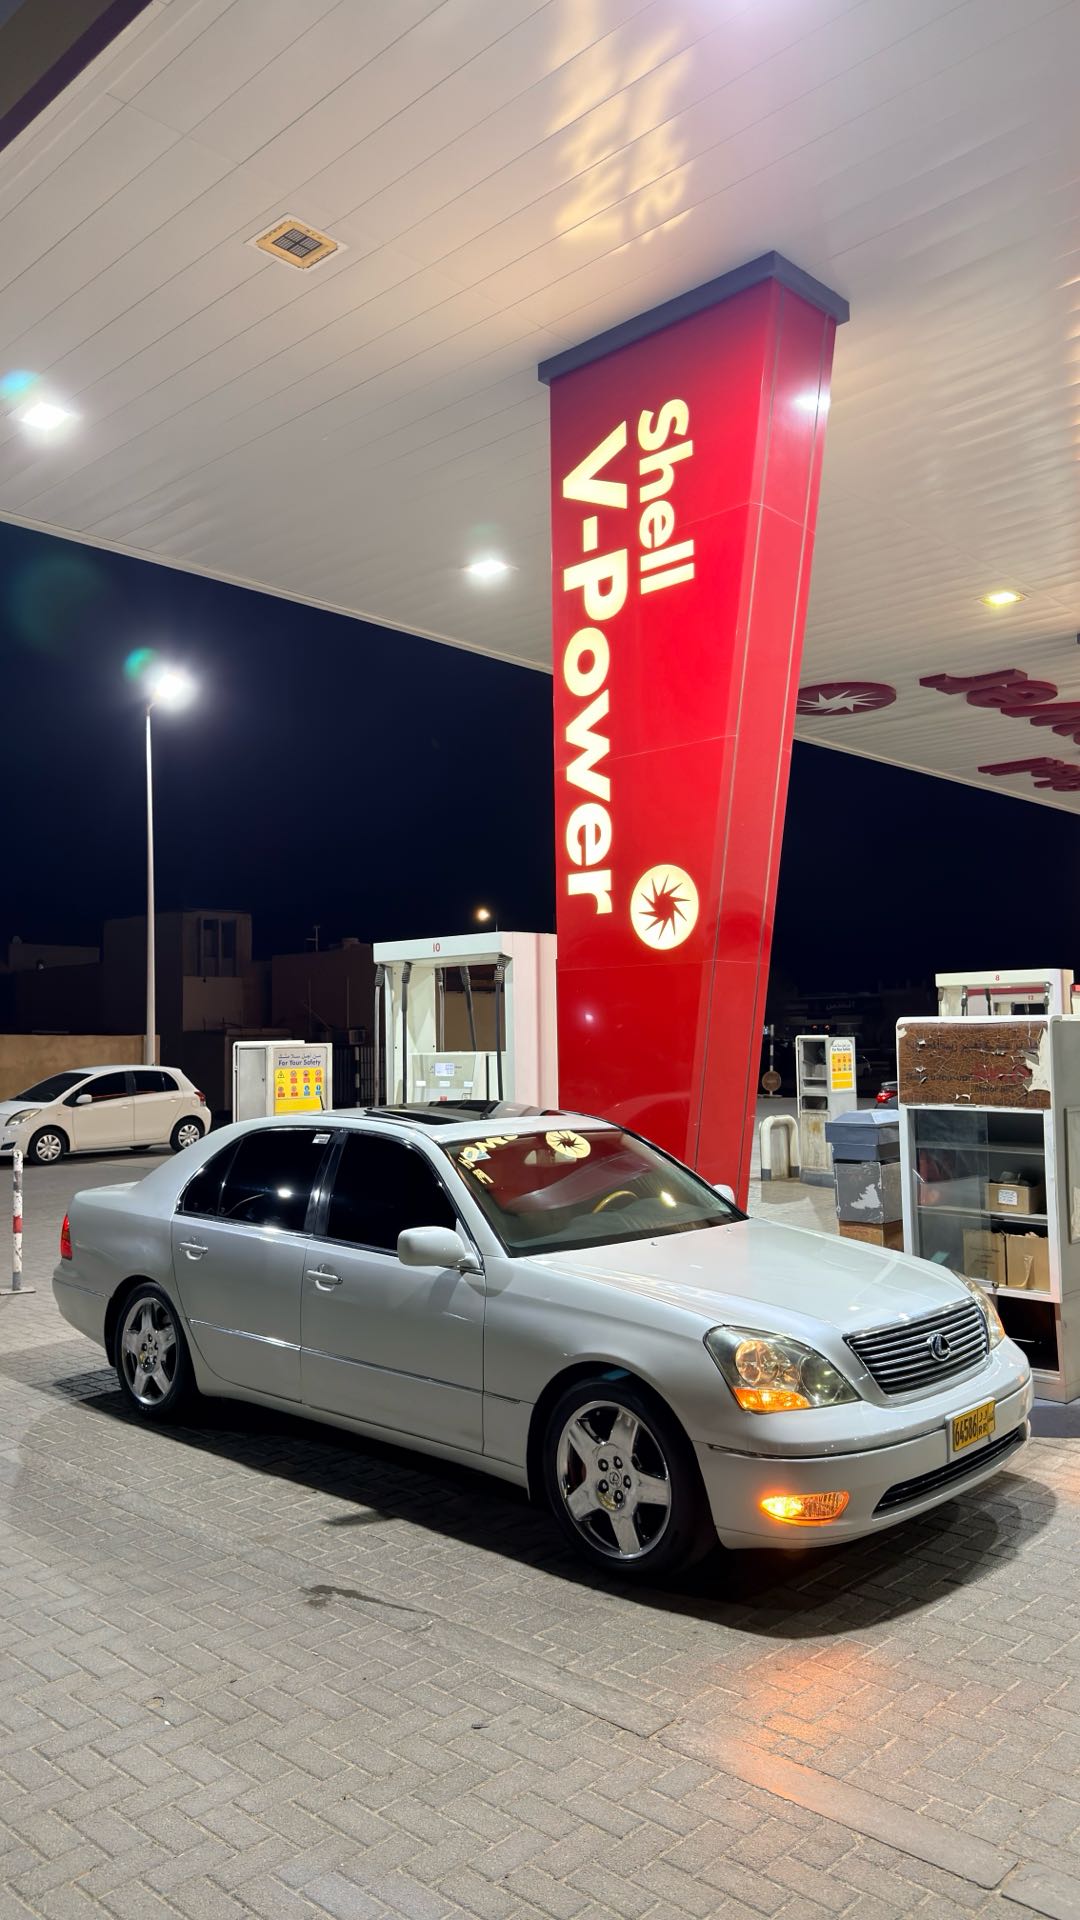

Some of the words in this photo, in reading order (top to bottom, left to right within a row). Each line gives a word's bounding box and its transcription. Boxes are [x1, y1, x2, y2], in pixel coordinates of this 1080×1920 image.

[637, 398, 696, 596] Shell
[561, 419, 630, 916] V-Power
[432, 942, 441, 953] 10
[303, 1059, 321, 1067] Safety
[955, 1413, 977, 1446] 64586
